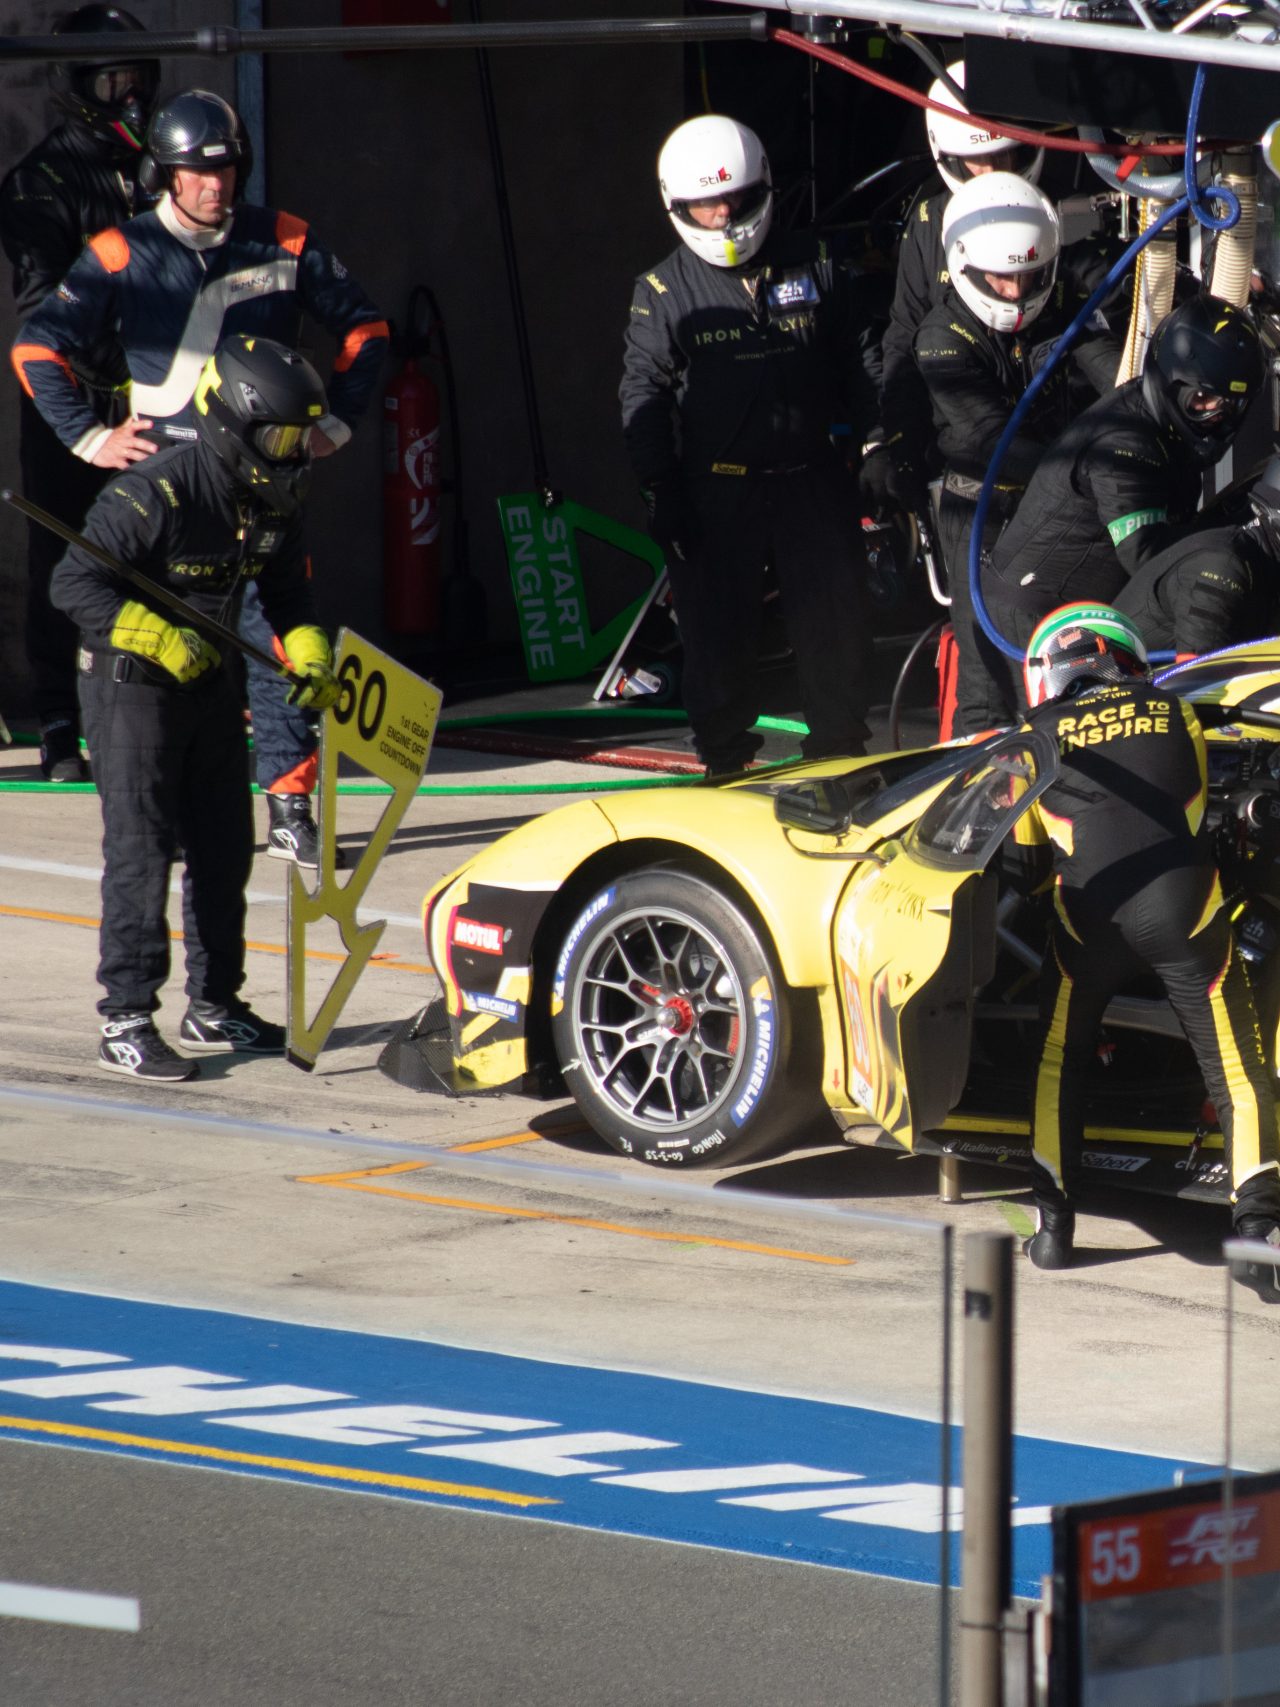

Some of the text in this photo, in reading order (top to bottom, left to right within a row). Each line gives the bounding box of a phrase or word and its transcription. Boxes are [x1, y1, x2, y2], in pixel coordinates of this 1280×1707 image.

[700, 167, 732, 188] Stilo
[1008, 246, 1039, 264] Stilo
[694, 328, 742, 345] IRON
[506, 506, 555, 669] ENGINE
[543, 516, 585, 650] START
[333, 654, 388, 742] 60
[401, 715, 430, 742] 1st GEAR
[1057, 701, 1170, 737] RACE TO
[1060, 717, 1170, 756] INSPIRE
[379, 741, 421, 776] COUNTDOWN
[387, 725, 426, 757] ENGINE OFF
[455, 921, 501, 951] MOTUL
[559, 892, 609, 977] MICHELIN
[477, 998, 517, 1016] MICHELIN
[735, 1019, 772, 1119] MICHELIN
[1082, 1152, 1137, 1171] Sabelt
[1091, 1525, 1140, 1585] 55
